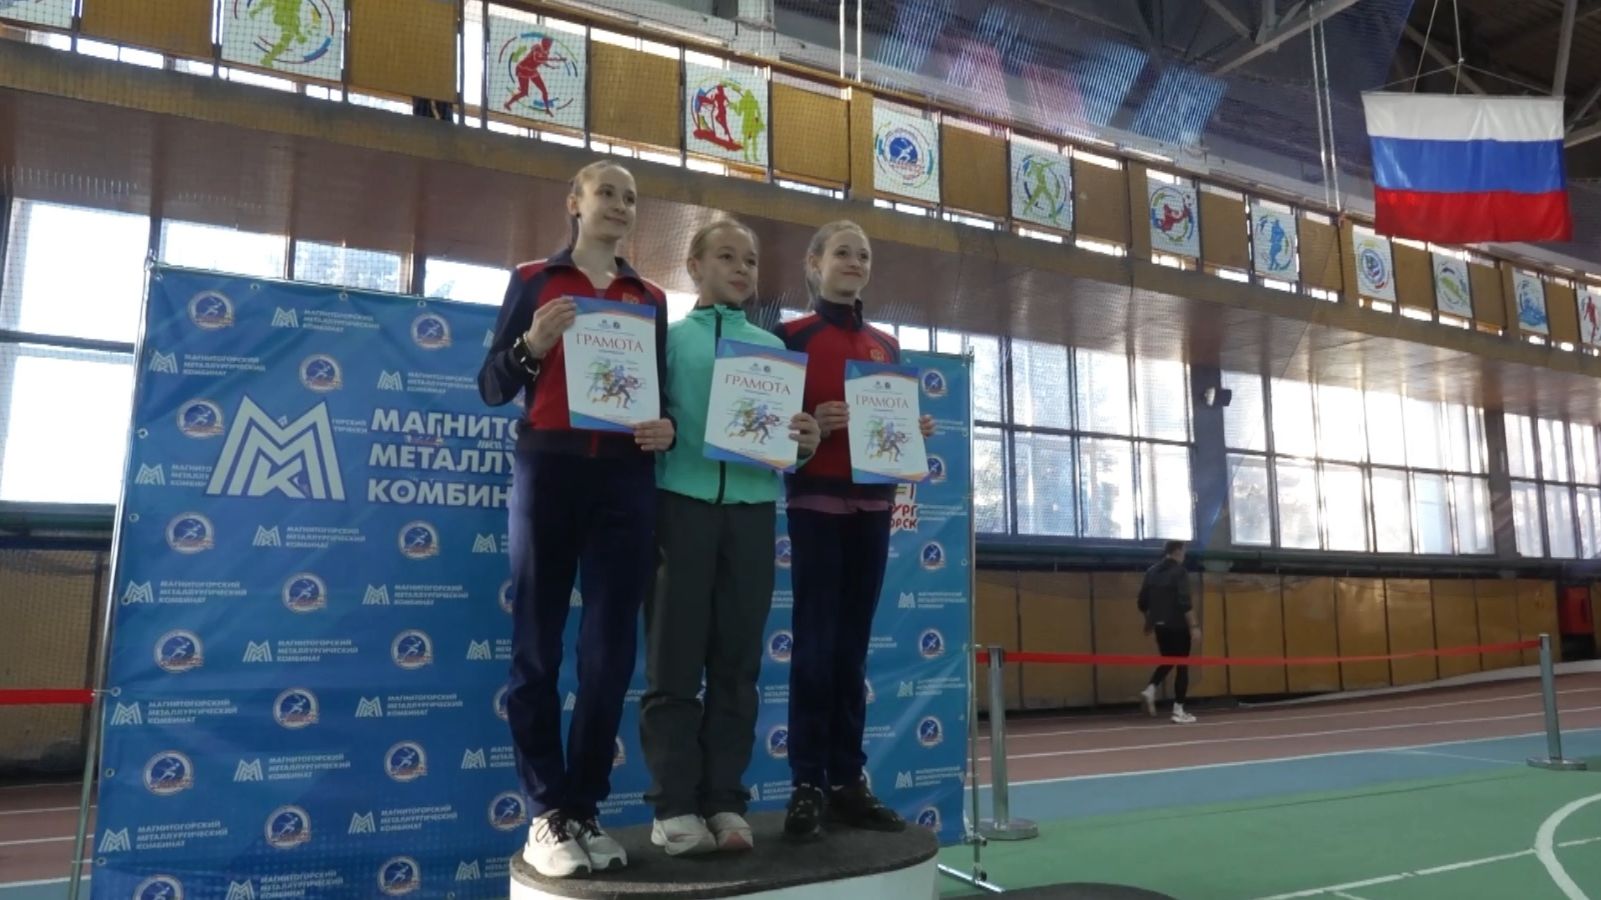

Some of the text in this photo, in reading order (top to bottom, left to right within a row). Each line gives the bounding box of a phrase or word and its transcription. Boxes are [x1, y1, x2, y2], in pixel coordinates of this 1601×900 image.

[576, 333, 644, 353] ГРАМОТА
[725, 374, 791, 395] ГРАМОТА
[855, 395, 909, 409] ГРАМОТА
